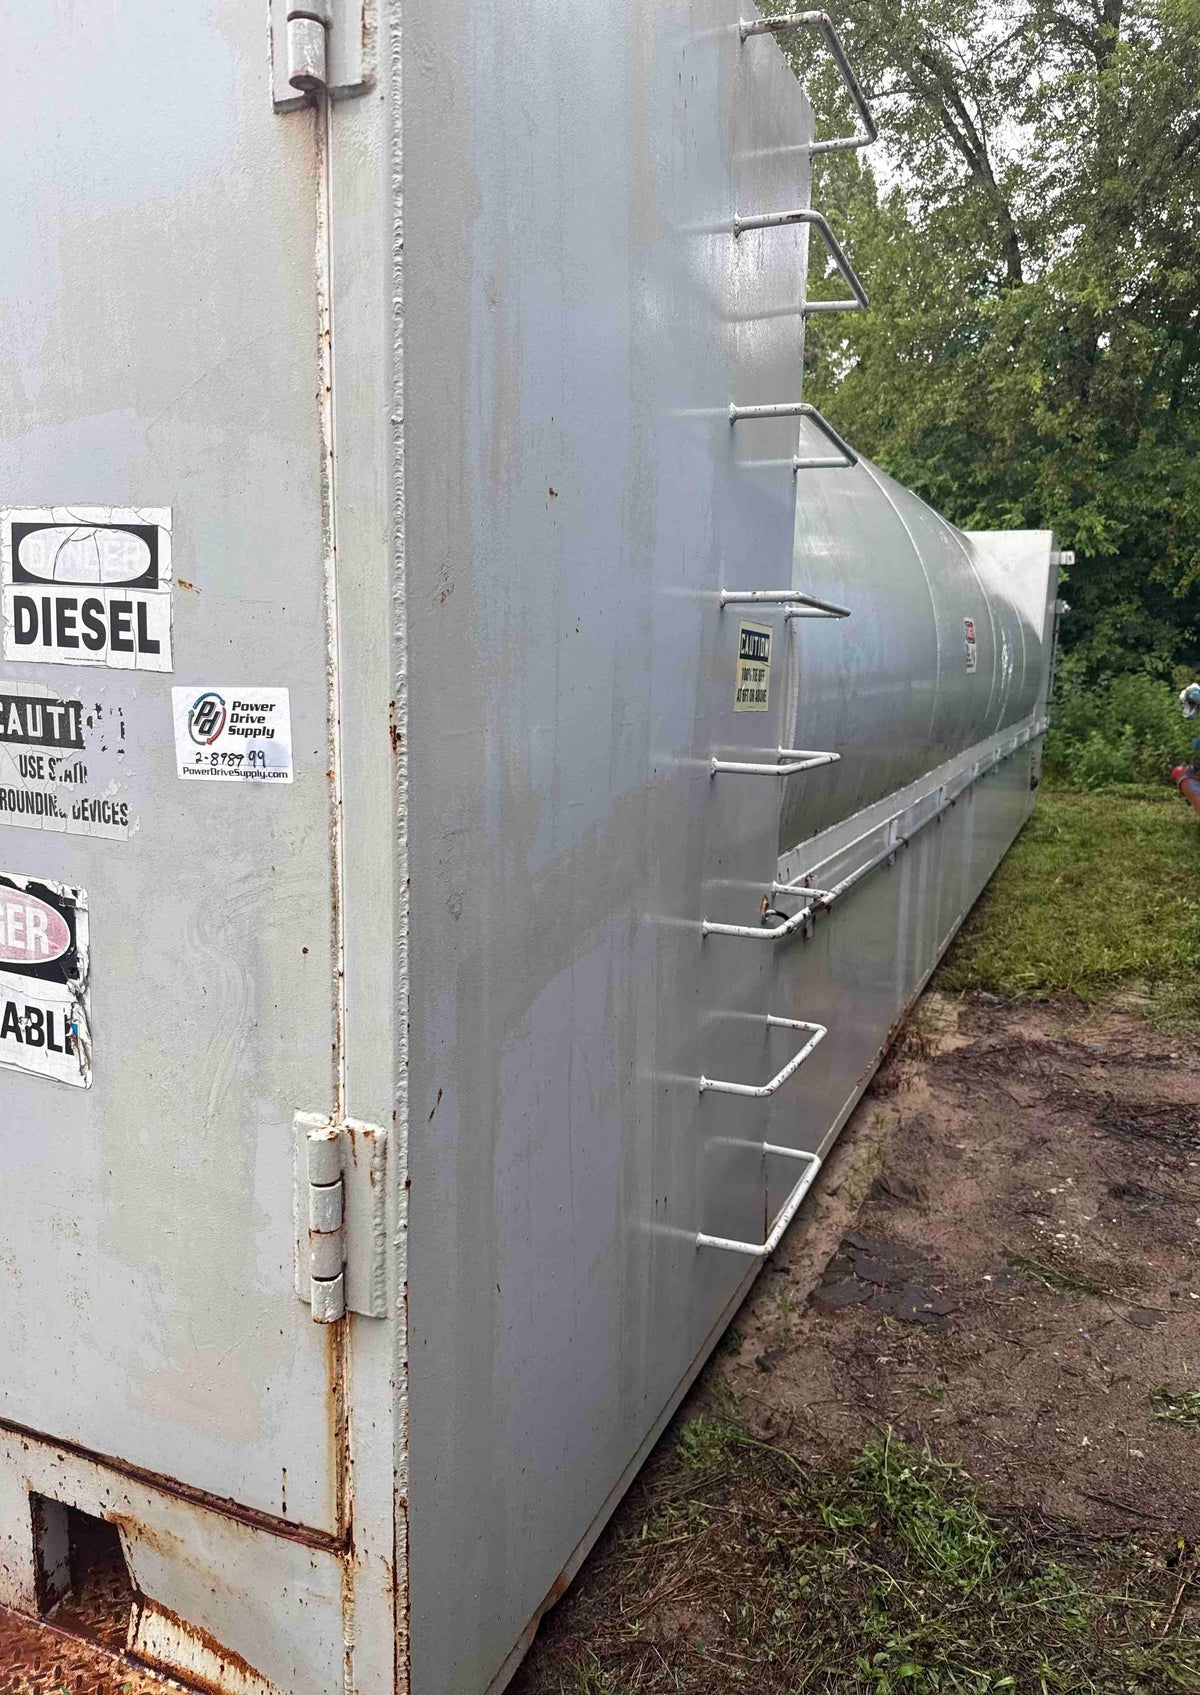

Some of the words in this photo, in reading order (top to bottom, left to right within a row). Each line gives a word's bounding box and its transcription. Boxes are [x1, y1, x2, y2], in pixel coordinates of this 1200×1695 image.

[13, 595, 160, 654] DIESEL
[740, 633, 769, 658] CAUTION
[230, 713, 266, 723] Drive
[231, 701, 276, 712] Power
[228, 725, 275, 738] Supply
[19, 754, 45, 780] USE
[182, 767, 288, 779] PowerDriveSupply.com
[72, 798, 128, 827] DEVICES
[0, 902, 49, 954] ER
